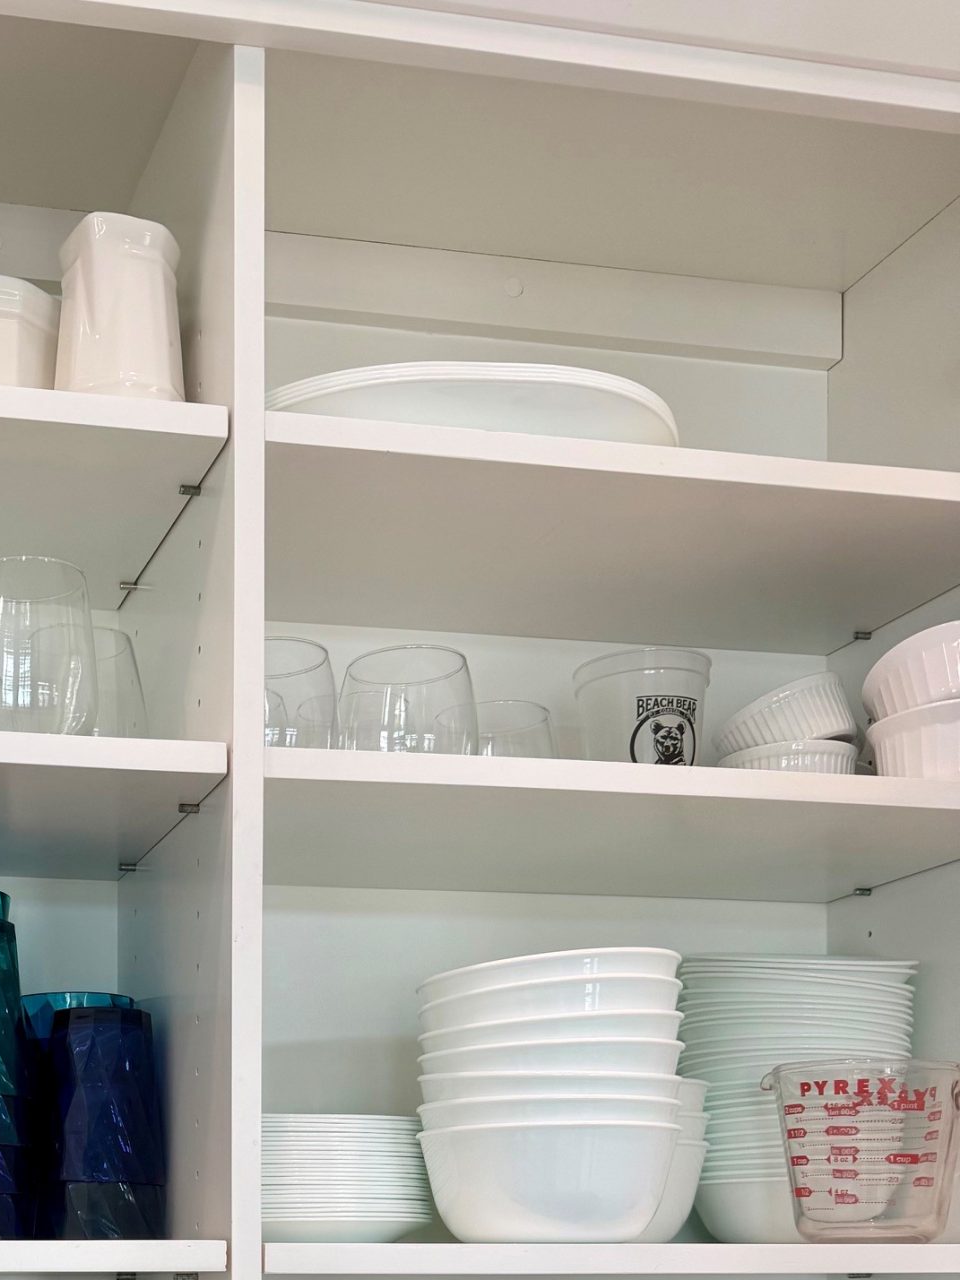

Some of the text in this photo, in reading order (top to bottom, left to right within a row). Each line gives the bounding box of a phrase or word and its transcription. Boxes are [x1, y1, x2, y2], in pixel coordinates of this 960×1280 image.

[637, 697, 674, 720] BEACH
[676, 699, 697, 724] BEAR
[800, 1077, 897, 1097] PYREX
